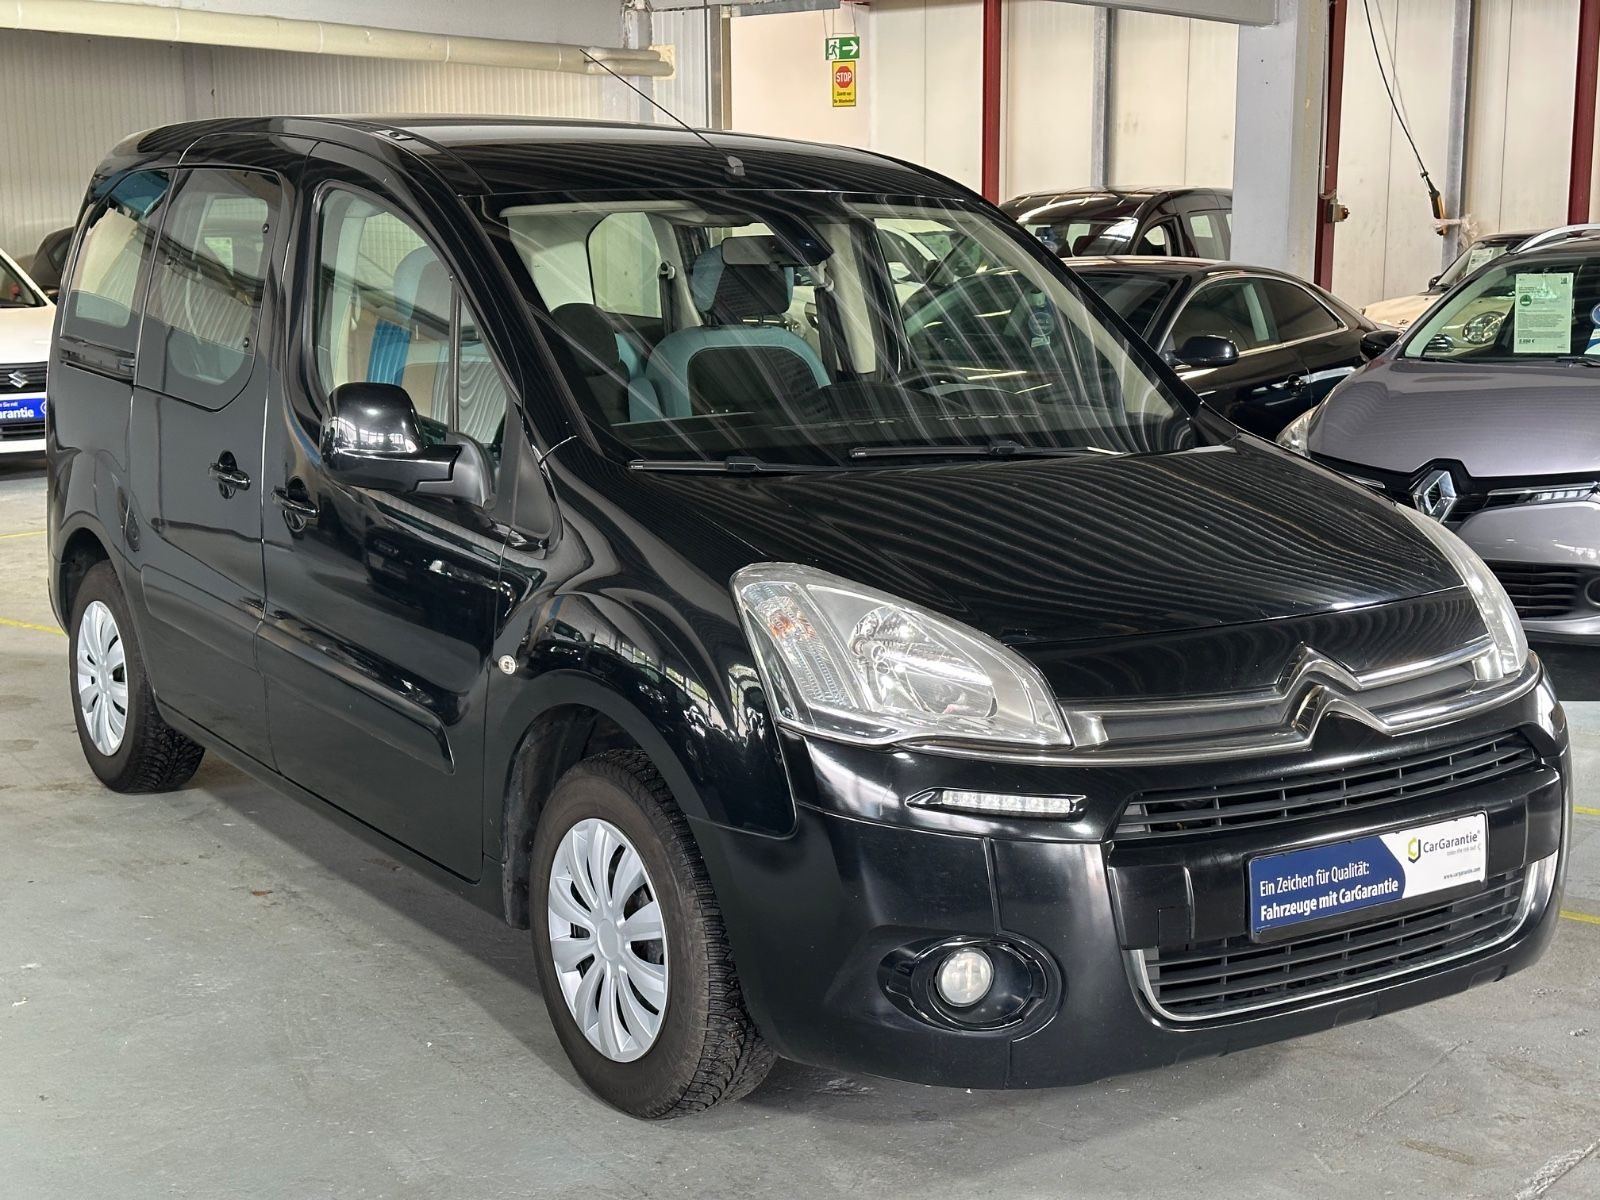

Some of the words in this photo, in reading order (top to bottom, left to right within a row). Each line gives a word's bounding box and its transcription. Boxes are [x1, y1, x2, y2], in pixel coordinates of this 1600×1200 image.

[837, 72, 852, 82] STOP
[1260, 880, 1275, 897] Ein
[1276, 873, 1314, 894] Zeichen
[1316, 868, 1330, 886] für
[1331, 860, 1370, 883] Qualität:
[1260, 898, 1317, 922] Fahrzeuge
[1318, 890, 1338, 909] mit
[1339, 877, 1399, 904] CarGarantie
